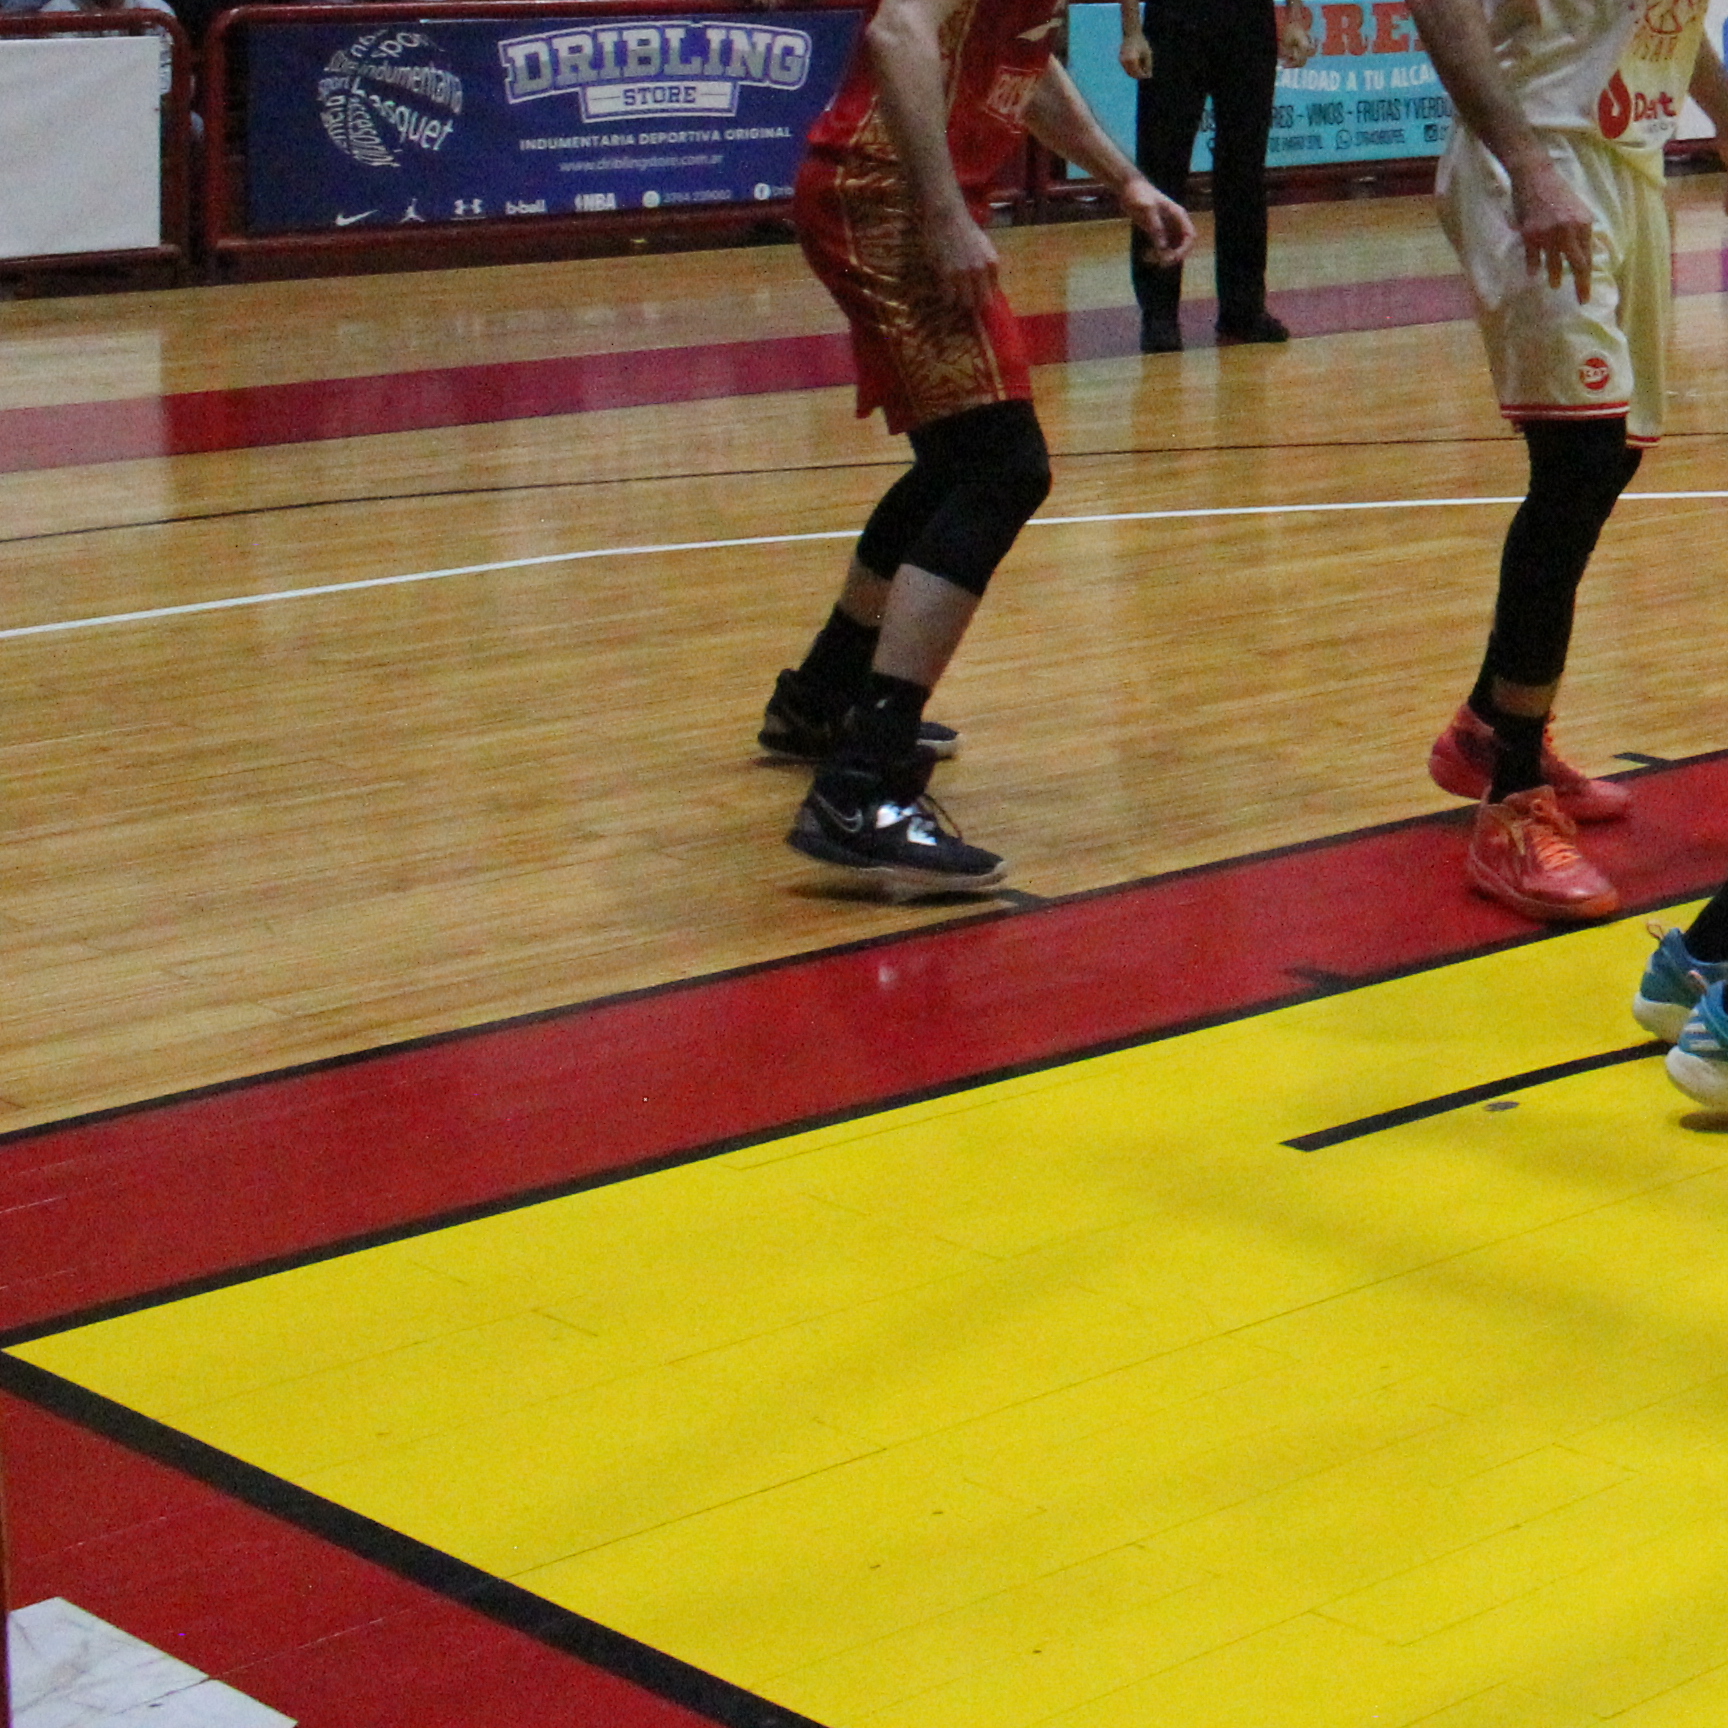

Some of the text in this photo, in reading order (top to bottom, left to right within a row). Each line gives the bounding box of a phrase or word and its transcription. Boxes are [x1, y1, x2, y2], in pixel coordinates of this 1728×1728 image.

[507, 28, 807, 95] DRIBLING
[1364, 69, 1385, 90] TU
[1390, 63, 1438, 89] ALCA
[622, 86, 697, 107] STORE
[1356, 98, 1401, 123] FRUTAS
[519, 126, 792, 151] INDUMENTARIA DEPORTIVA ORIGINAL
[581, 192, 617, 212] NBA
